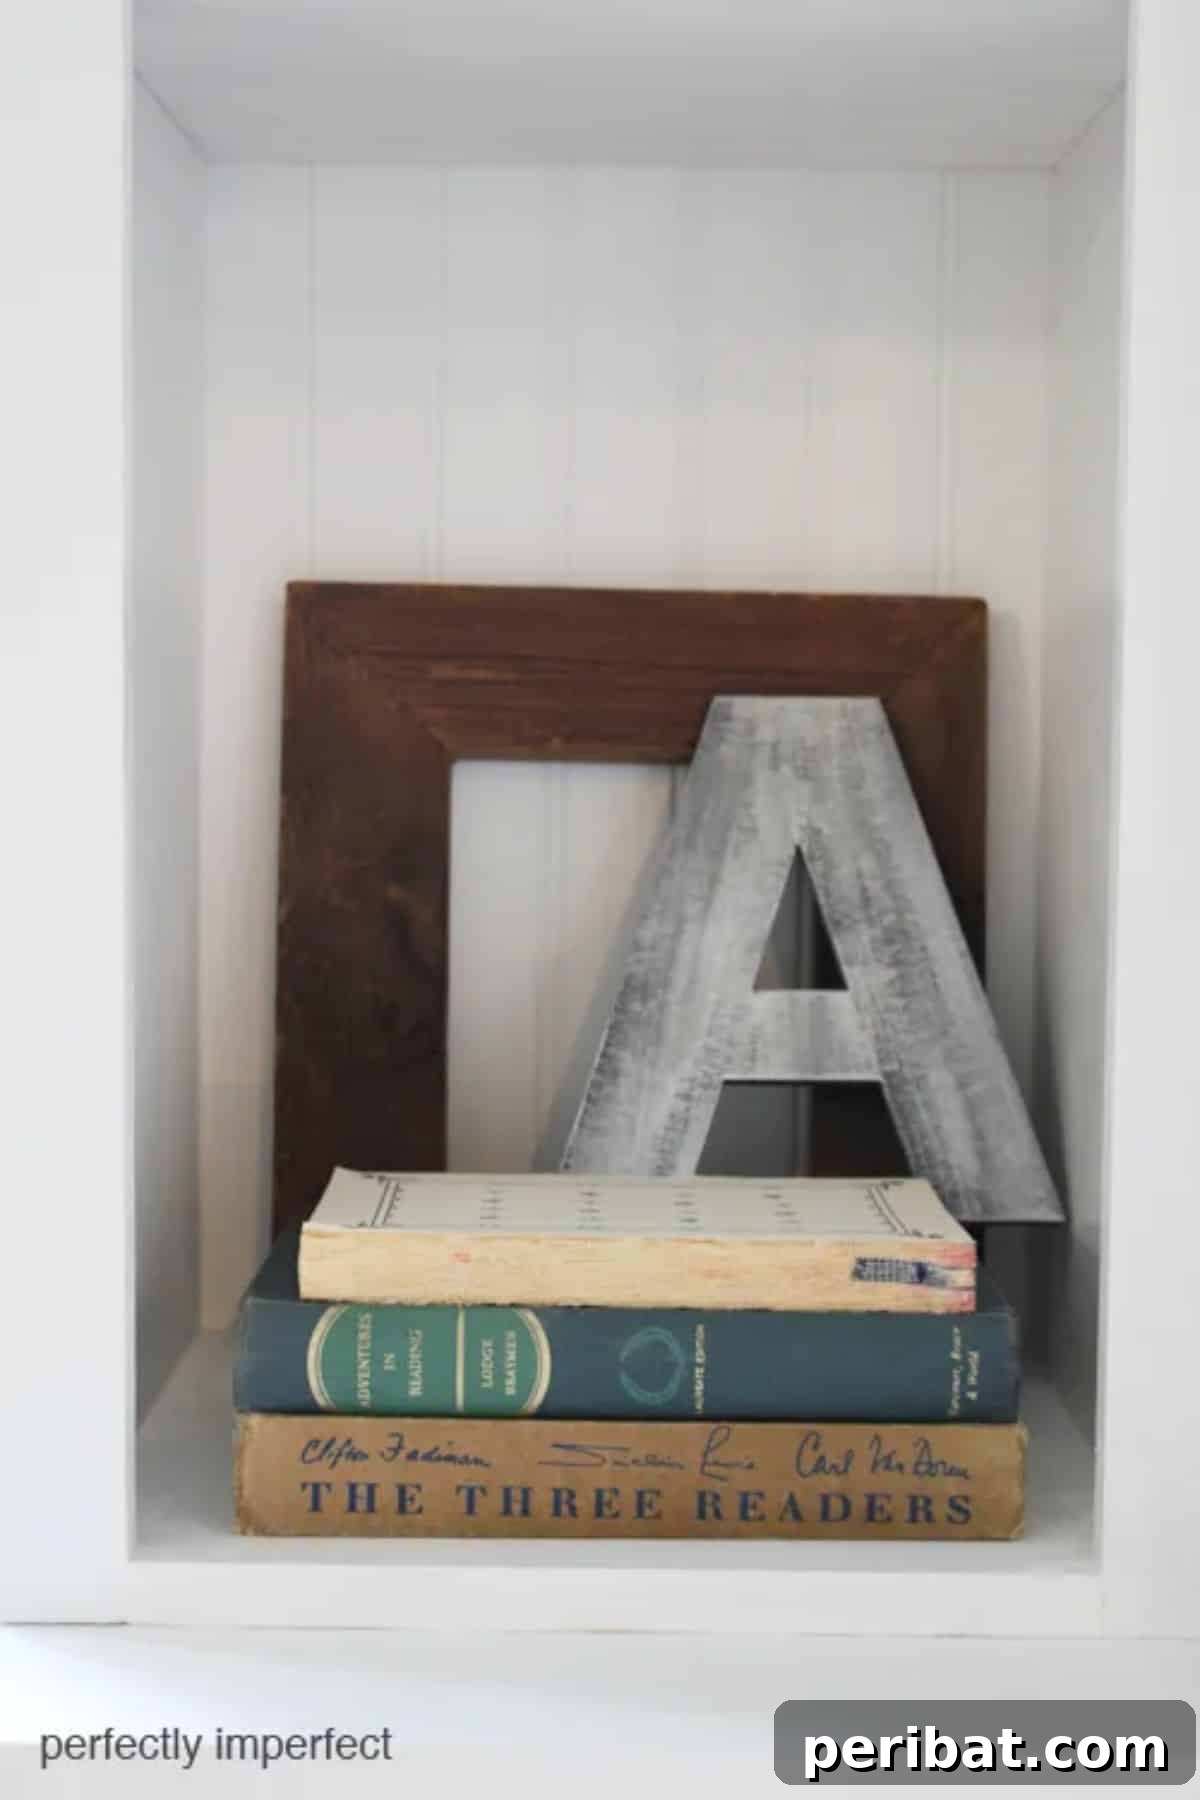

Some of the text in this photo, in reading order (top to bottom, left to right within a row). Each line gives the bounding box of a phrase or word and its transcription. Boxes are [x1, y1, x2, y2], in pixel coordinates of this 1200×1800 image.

[356, 1312, 373, 1409] ADVENTURES
[383, 1352, 397, 1371] IN
[408, 1327, 424, 1398] READING
[480, 1337, 494, 1389] LODGE
[796, 1430, 855, 1478] Carl
[301, 1481, 972, 1525] THE THREE READERS
